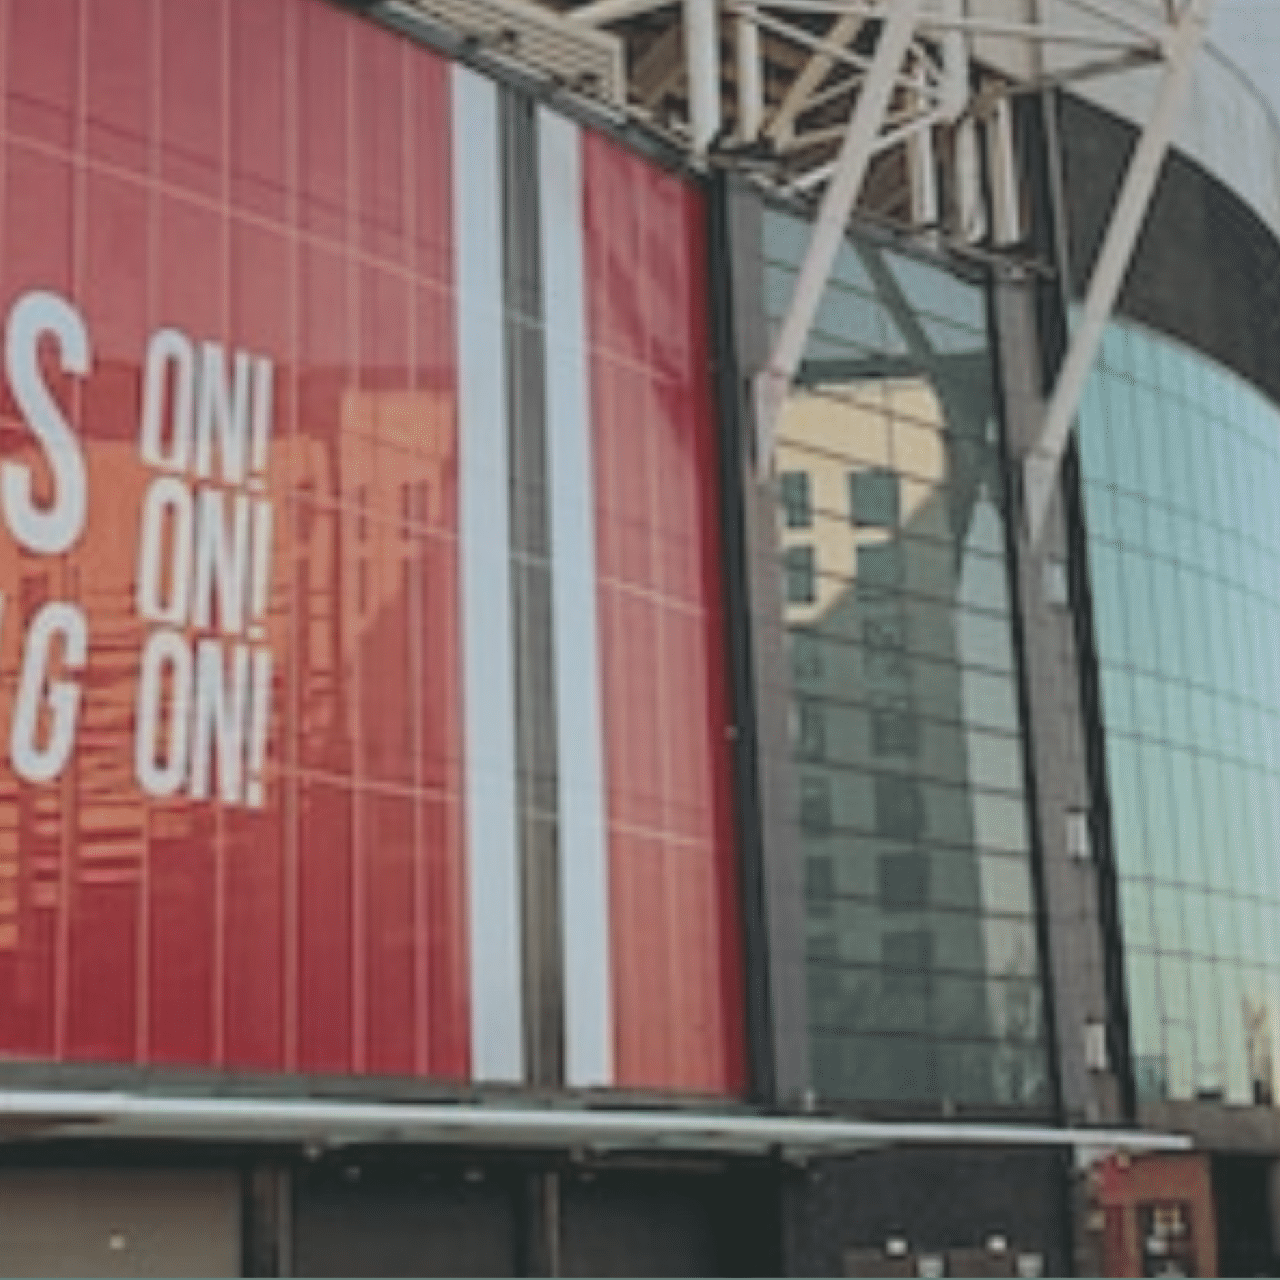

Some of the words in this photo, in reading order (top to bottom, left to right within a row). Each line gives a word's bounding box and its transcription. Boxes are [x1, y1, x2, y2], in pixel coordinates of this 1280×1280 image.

[140, 327, 275, 493] ON!
[136, 476, 272, 640] ON!
[135, 630, 272, 810] ON!
